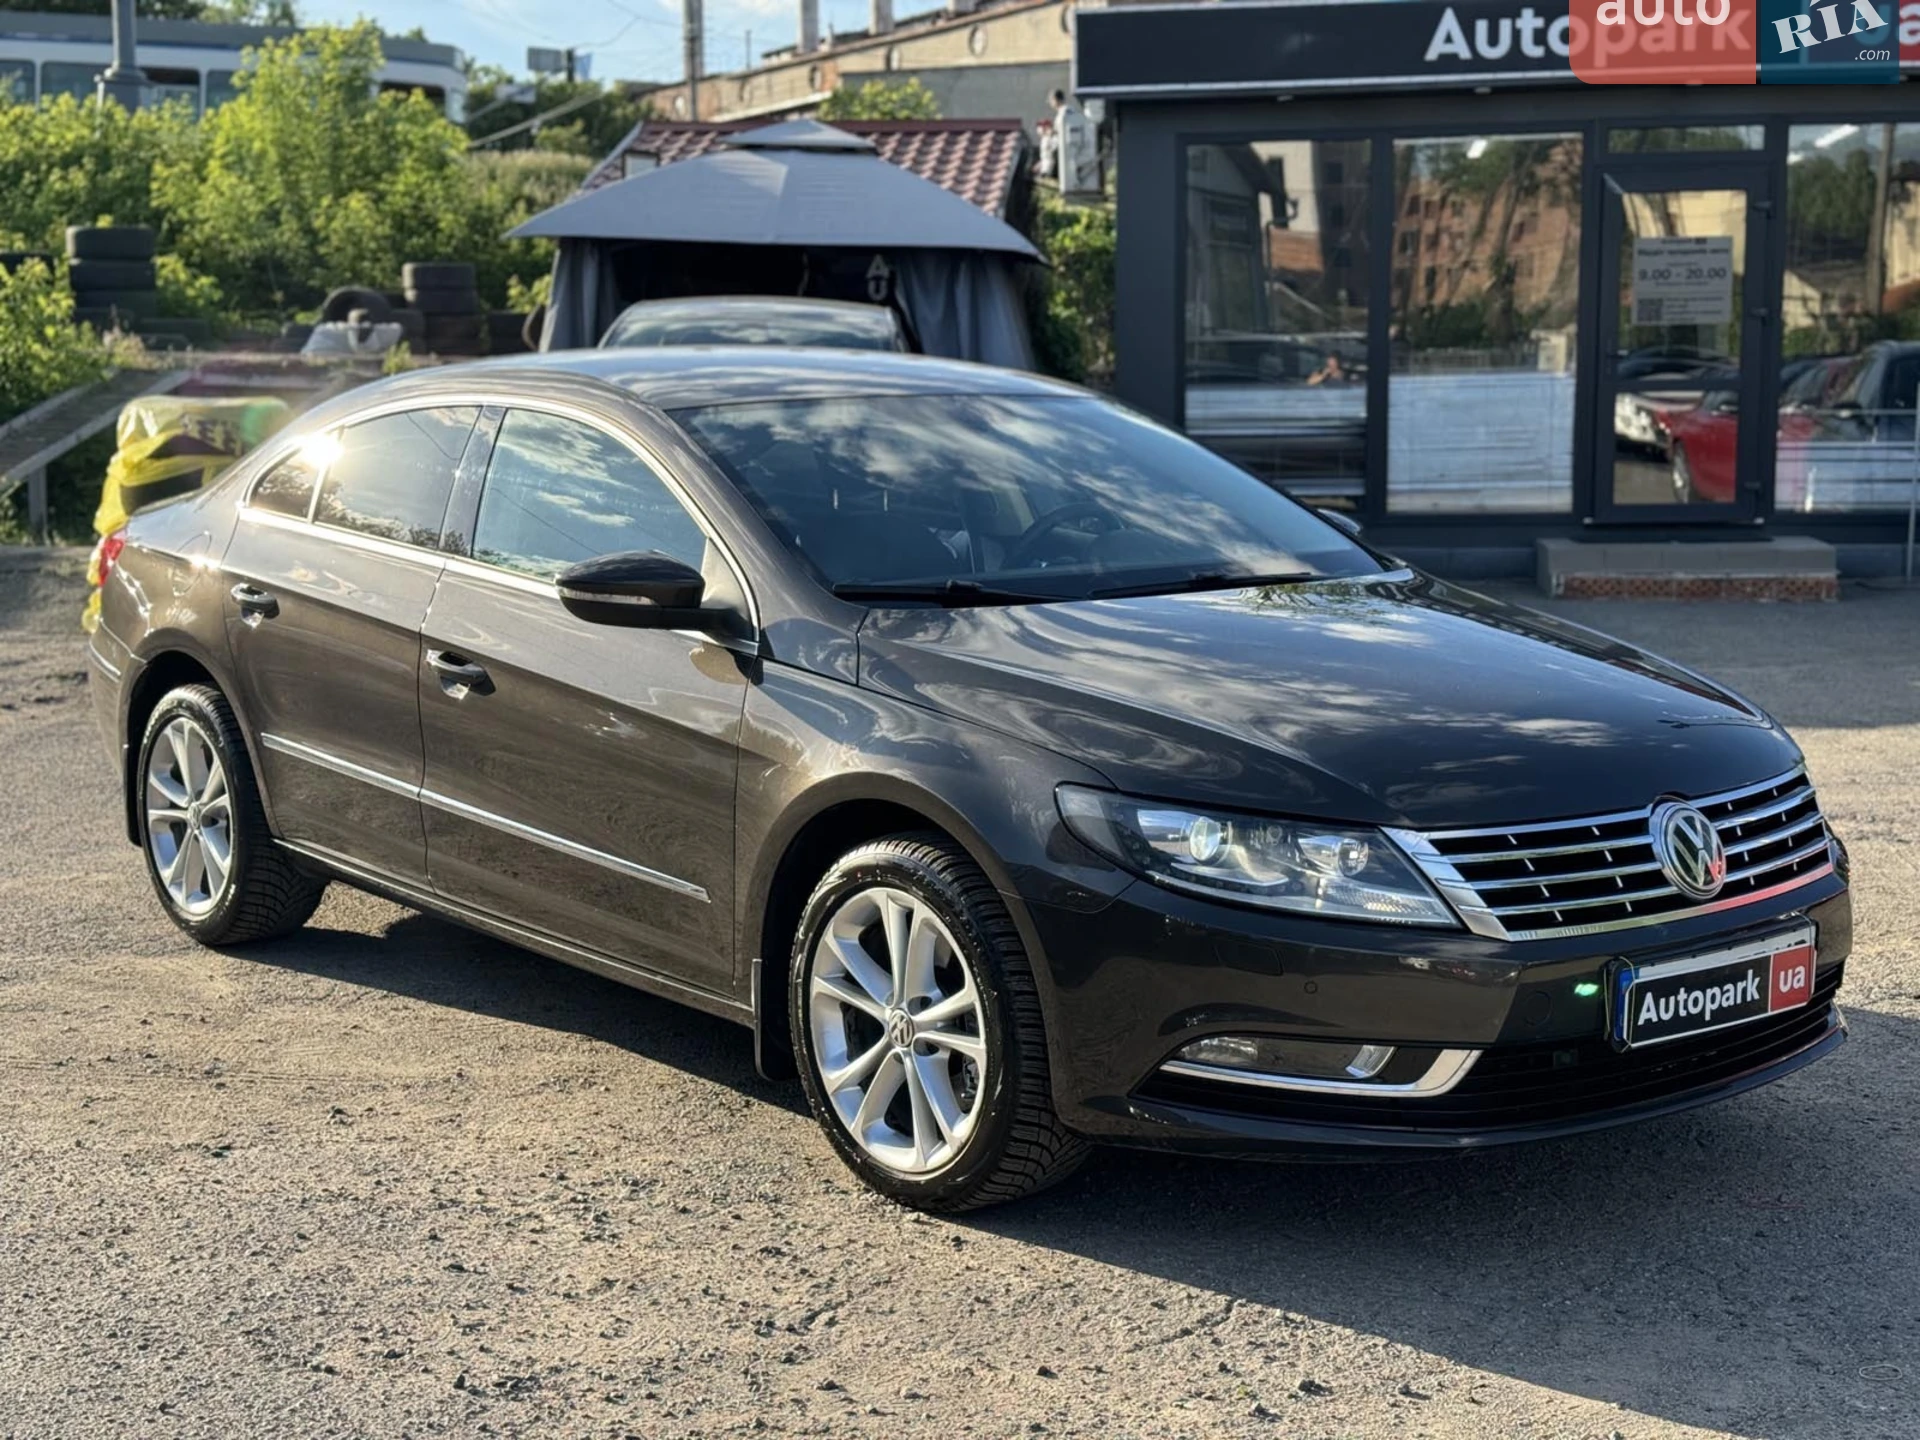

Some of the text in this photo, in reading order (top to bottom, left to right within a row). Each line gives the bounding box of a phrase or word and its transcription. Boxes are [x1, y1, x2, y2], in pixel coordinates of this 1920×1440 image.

[1424, 0, 1752, 67] Autopark
[1637, 964, 1806, 1026] Autopark ua
